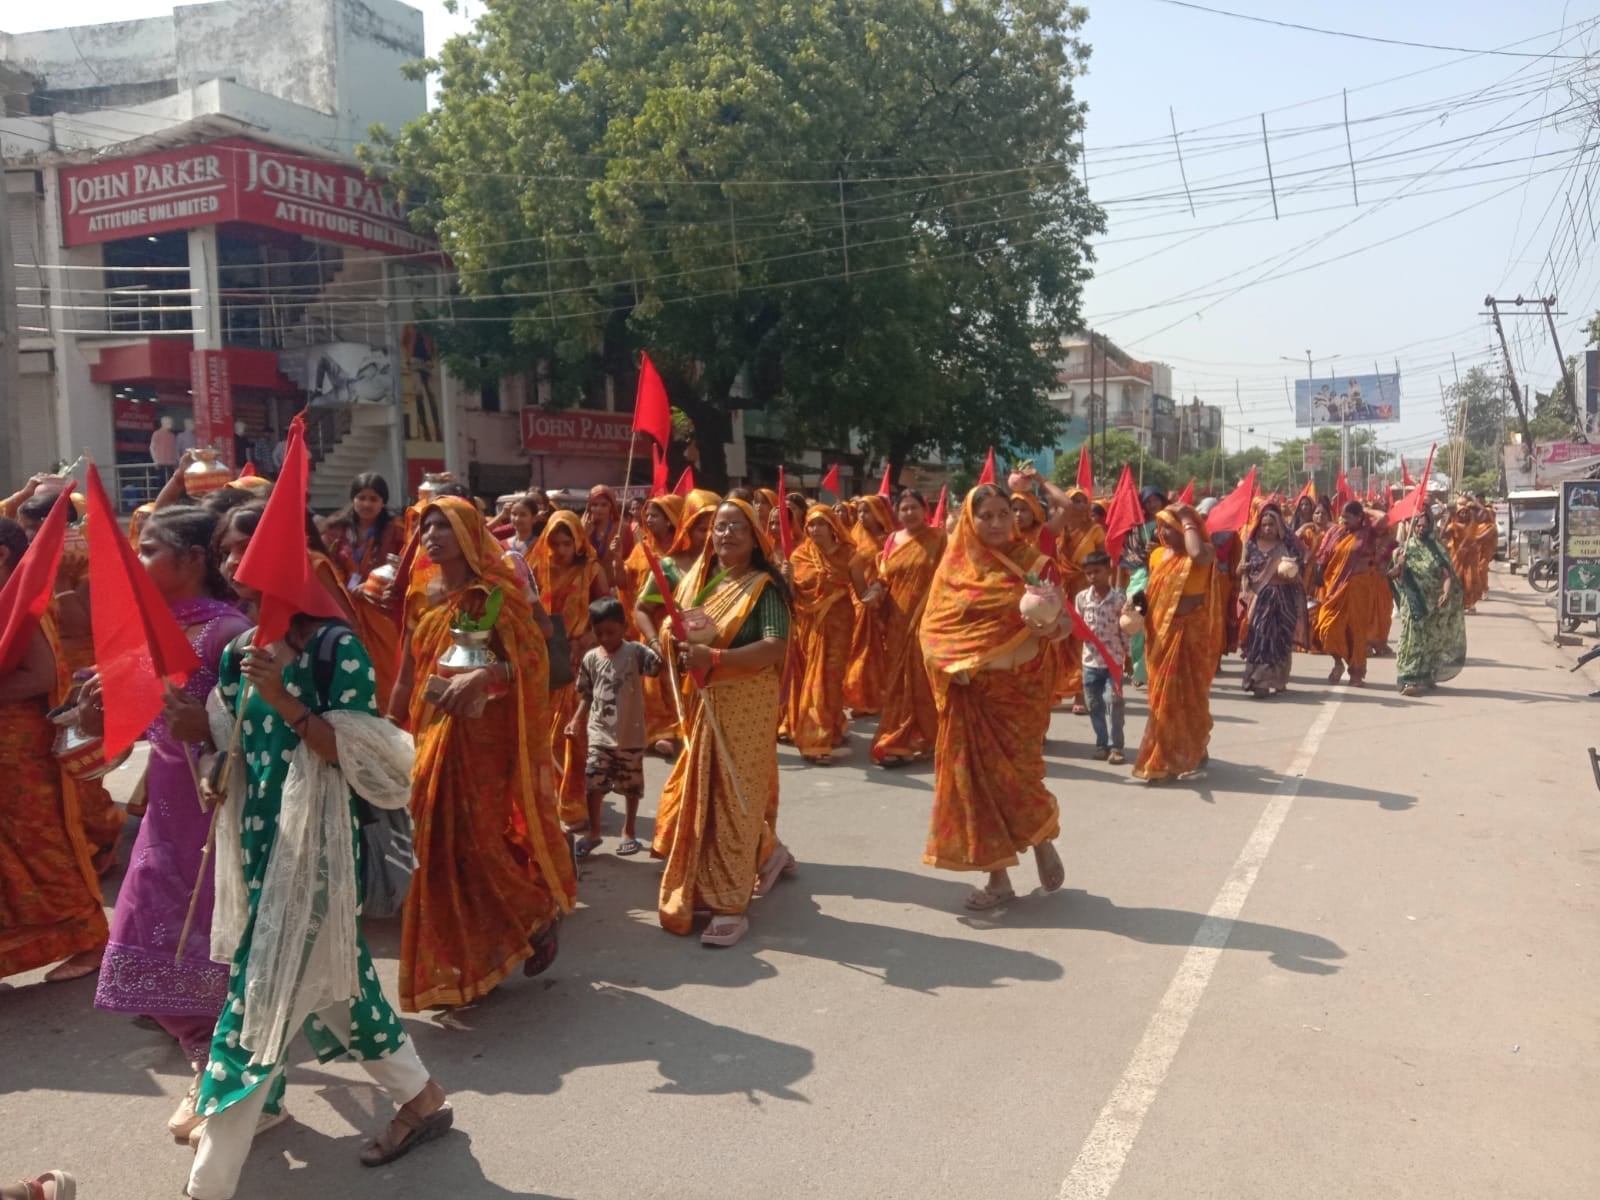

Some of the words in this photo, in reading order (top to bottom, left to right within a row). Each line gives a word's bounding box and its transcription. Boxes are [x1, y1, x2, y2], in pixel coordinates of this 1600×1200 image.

[68, 171, 129, 214] JOHN
[133, 154, 224, 195] PARKER
[244, 149, 336, 203] JOHN
[344, 175, 406, 221] PAR
[88, 207, 148, 232] ATTITUDE
[150, 195, 219, 222] UNLIMITED
[275, 201, 360, 237] ATTITUDE
[527, 413, 576, 439] JOHN
